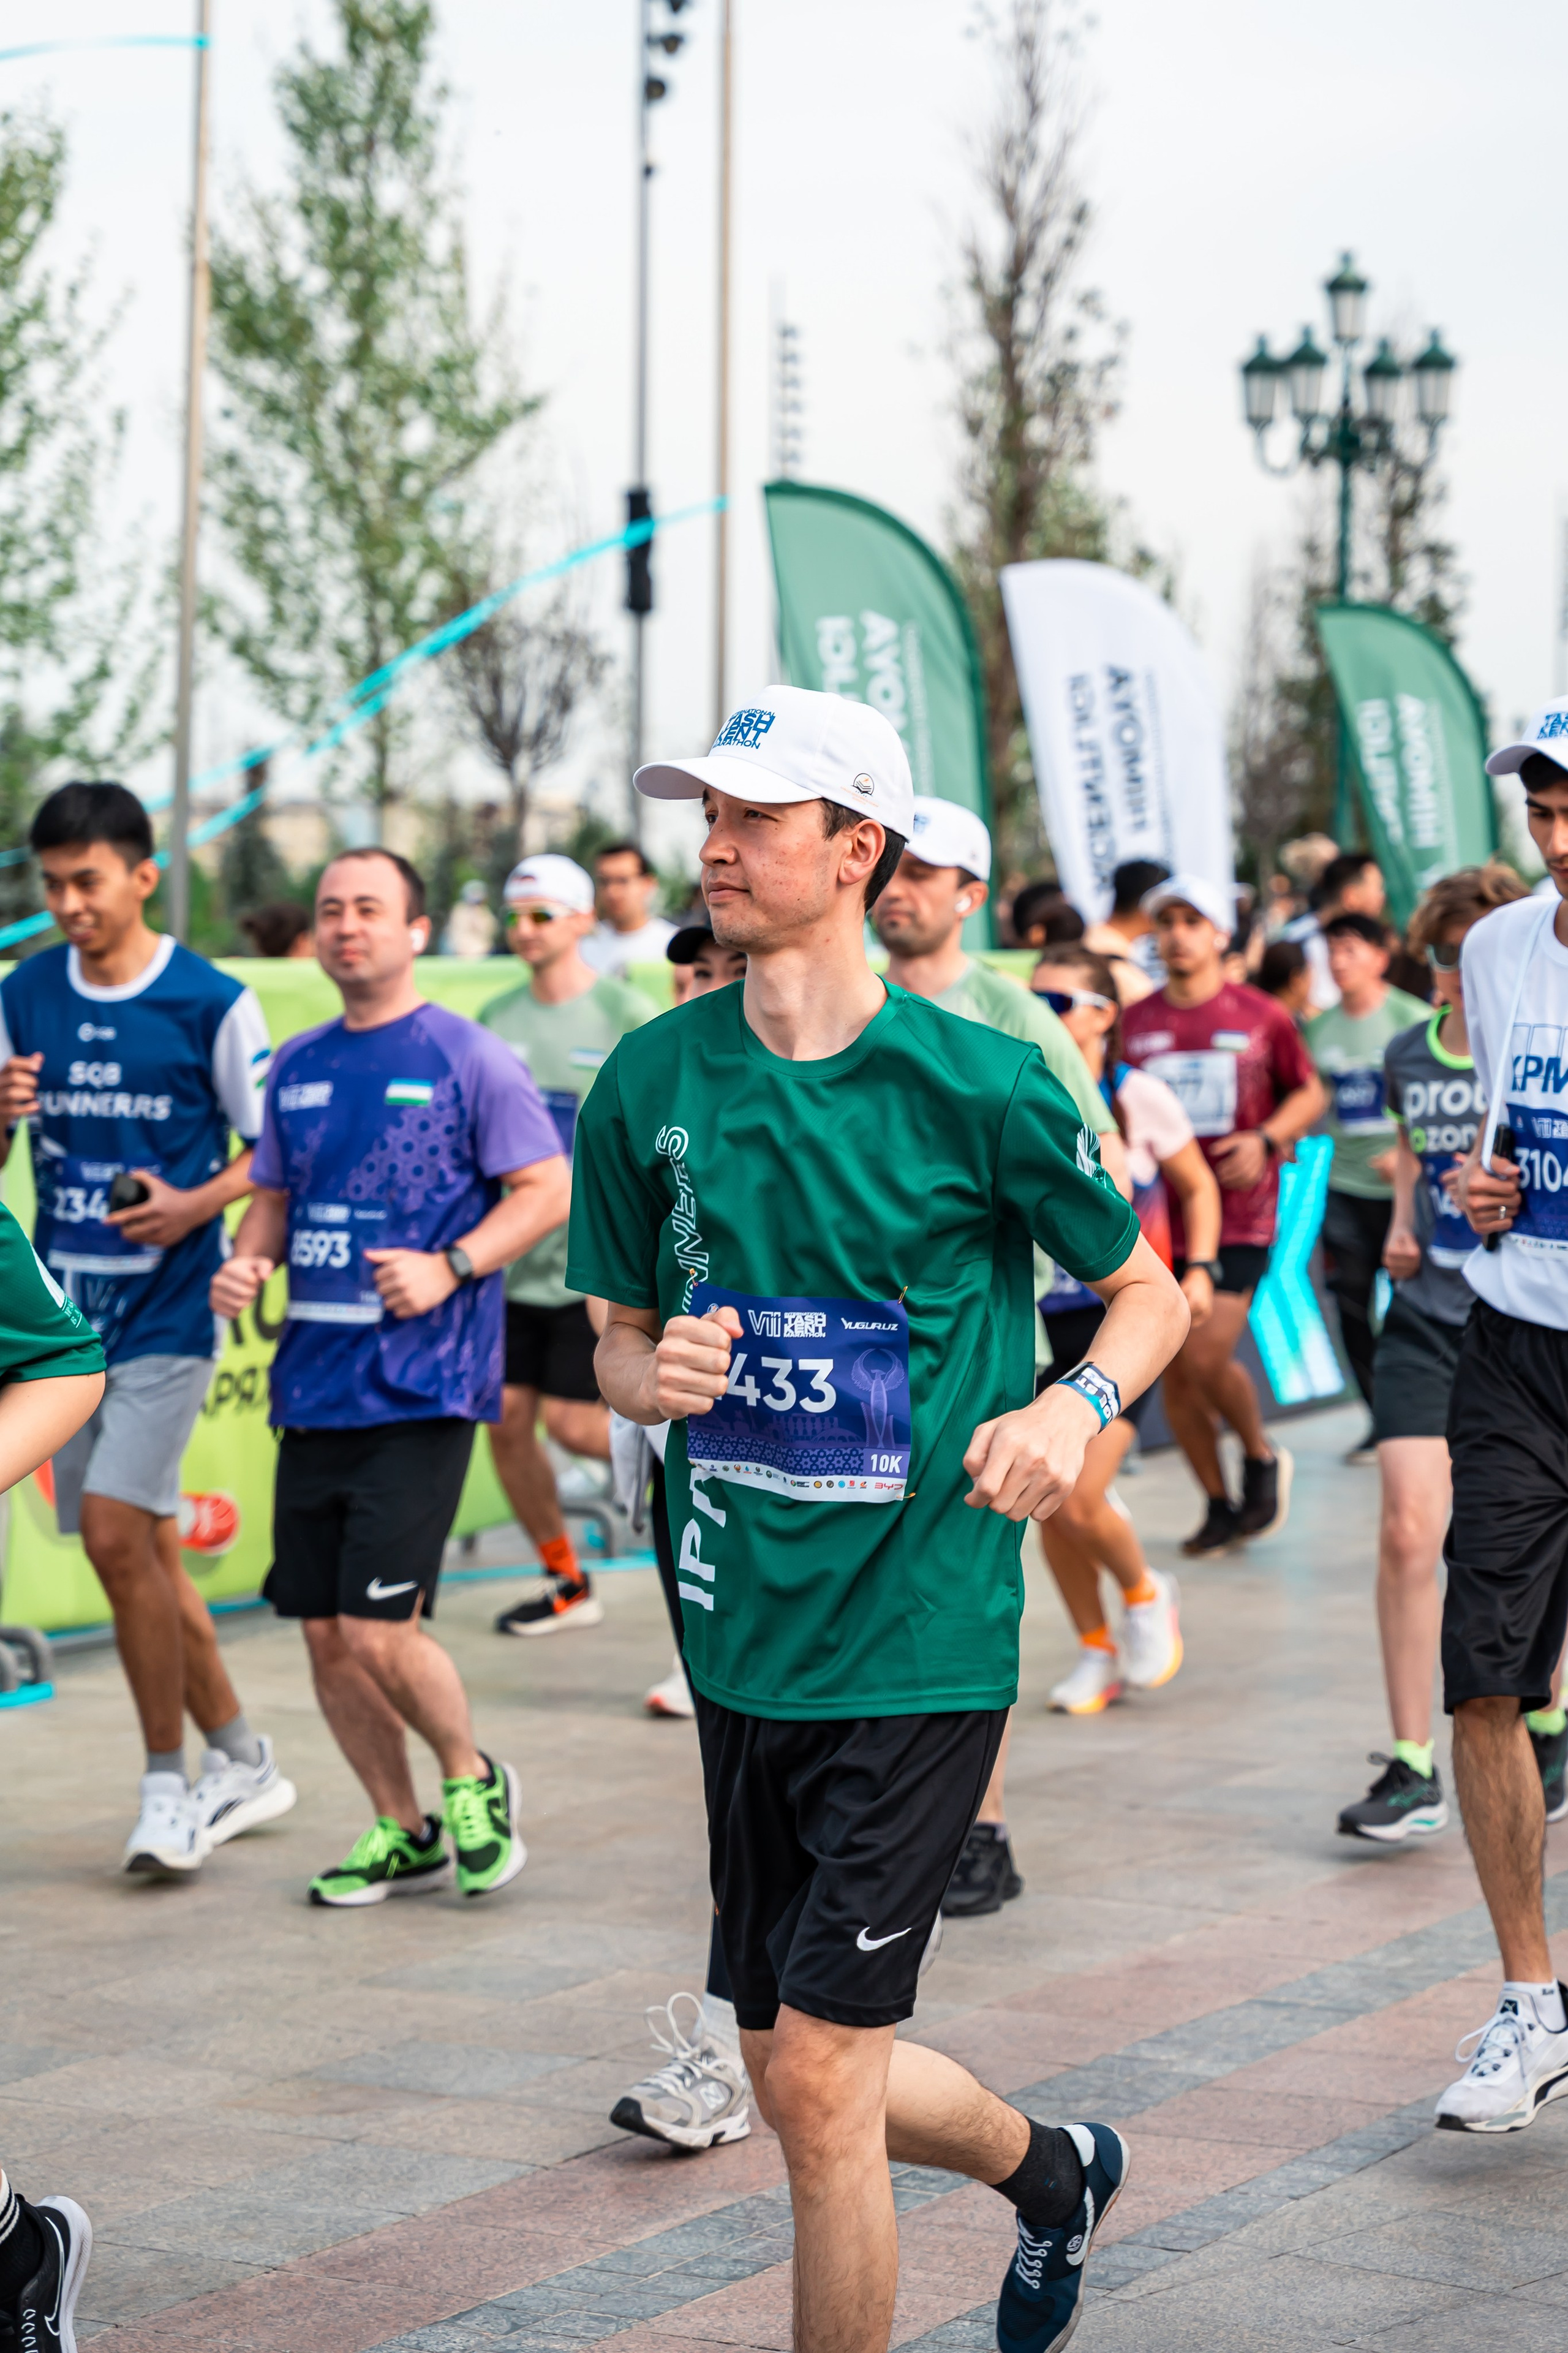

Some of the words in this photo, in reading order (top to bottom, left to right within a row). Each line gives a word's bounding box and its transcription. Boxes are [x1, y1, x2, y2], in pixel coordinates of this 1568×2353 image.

[67, 1060, 123, 1090] SQB
[784, 1315, 826, 1327] TASH
[784, 1323, 824, 1334] KENT
[715, 1353, 837, 1413] 433
[870, 1454, 903, 1474] 10K
